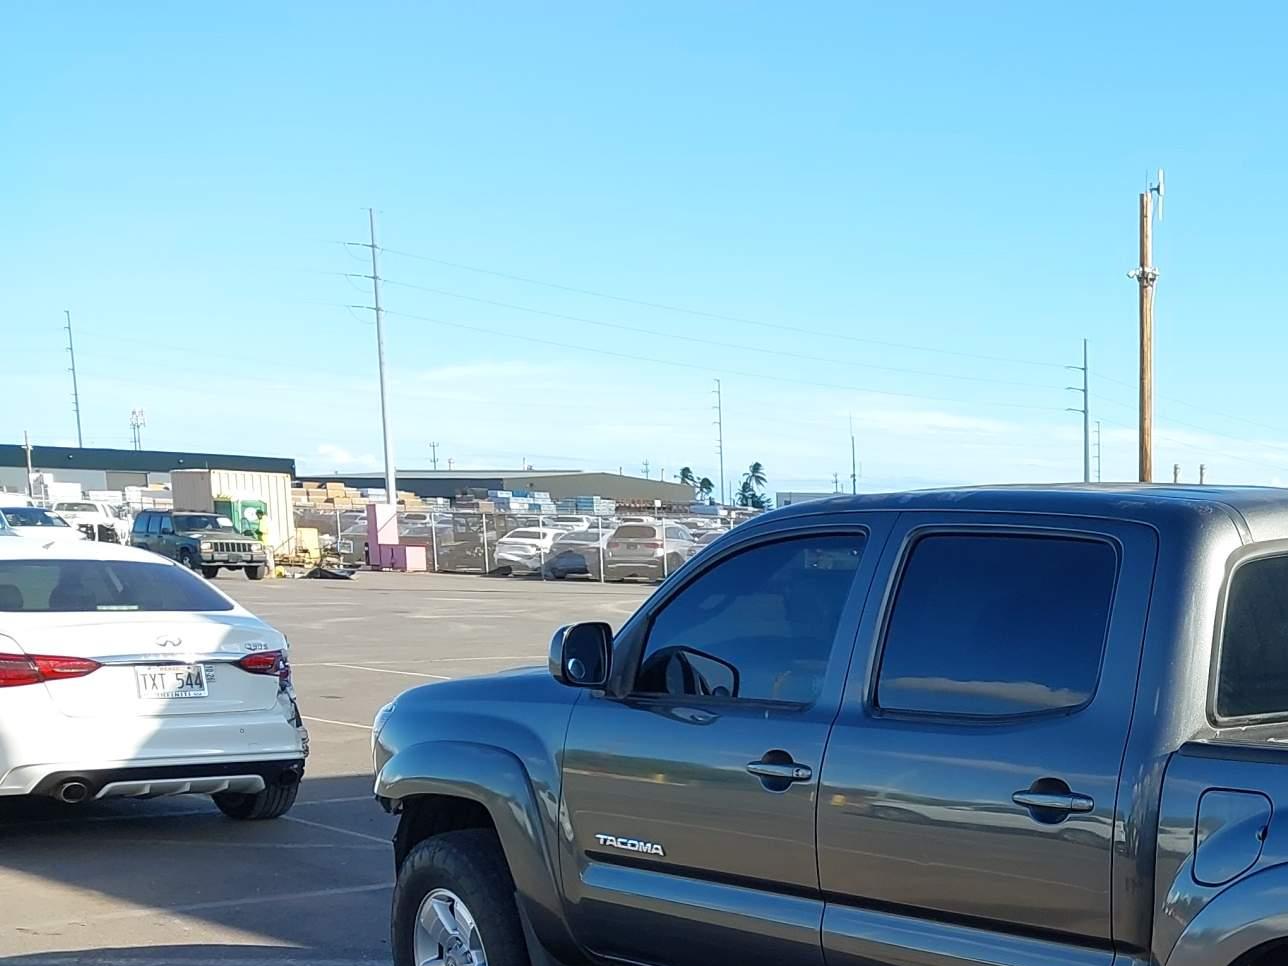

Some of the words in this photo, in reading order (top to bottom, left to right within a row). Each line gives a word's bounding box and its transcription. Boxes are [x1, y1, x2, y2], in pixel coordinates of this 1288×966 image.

[139, 673, 166, 691] TXT
[175, 671, 204, 690] 544
[594, 833, 665, 857] TACOMA
